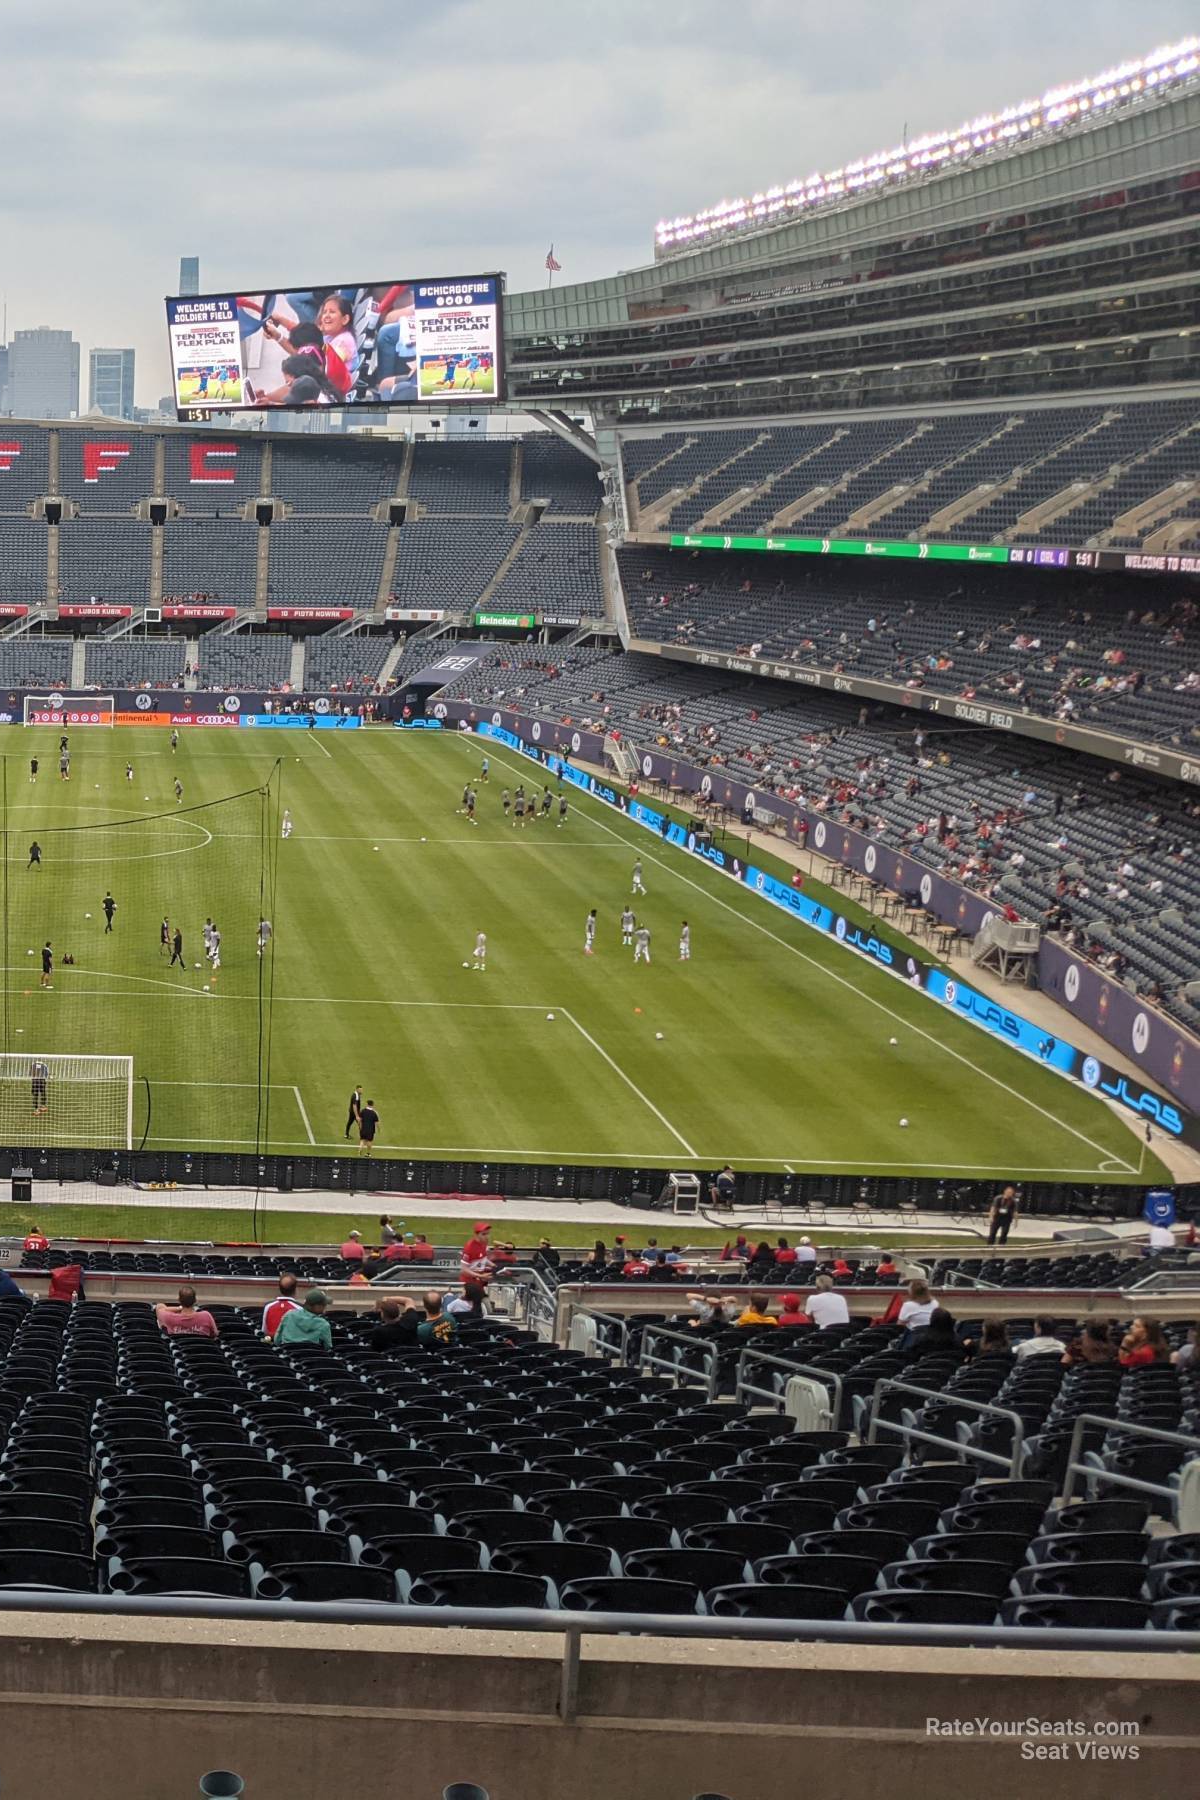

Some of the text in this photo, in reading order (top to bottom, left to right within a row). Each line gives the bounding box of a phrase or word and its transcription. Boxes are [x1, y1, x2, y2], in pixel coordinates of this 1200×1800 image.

[419, 283, 489, 296] @CHICAGOFIRE
[176, 302, 229, 313] WELCOME TO
[174, 310, 233, 322] SOLDIER FIELD
[420, 315, 491, 326] TEN TICKET
[421, 323, 489, 333] FLEX PLAN
[175, 331, 235, 341] TEN TICKET
[177, 338, 235, 347] FLEX PLAN
[188, 409, 209, 421] 1:51
[84, 442, 130, 483] F
[190, 442, 237, 483] C
[1010, 550, 1023, 562] CHI
[1075, 553, 1091, 566] 1:51
[1125, 555, 1165, 570] WELCOME
[1167, 557, 1179, 571] TO
[315, 610, 341, 618] NOWAK
[479, 615, 518, 626] Heineken
[557, 617, 580, 625] CORNER
[172, 715, 192, 723] Audi
[954, 703, 987, 722] SOLDIER
[990, 712, 1013, 729] FIELD
[594, 784, 616, 803] JLAB
[695, 842, 725, 866] JLAB
[763, 886, 801, 911] JLAB
[846, 930, 893, 965] JLAB
[956, 996, 1021, 1039] JLAB
[1101, 1078, 1183, 1135] JLAB
